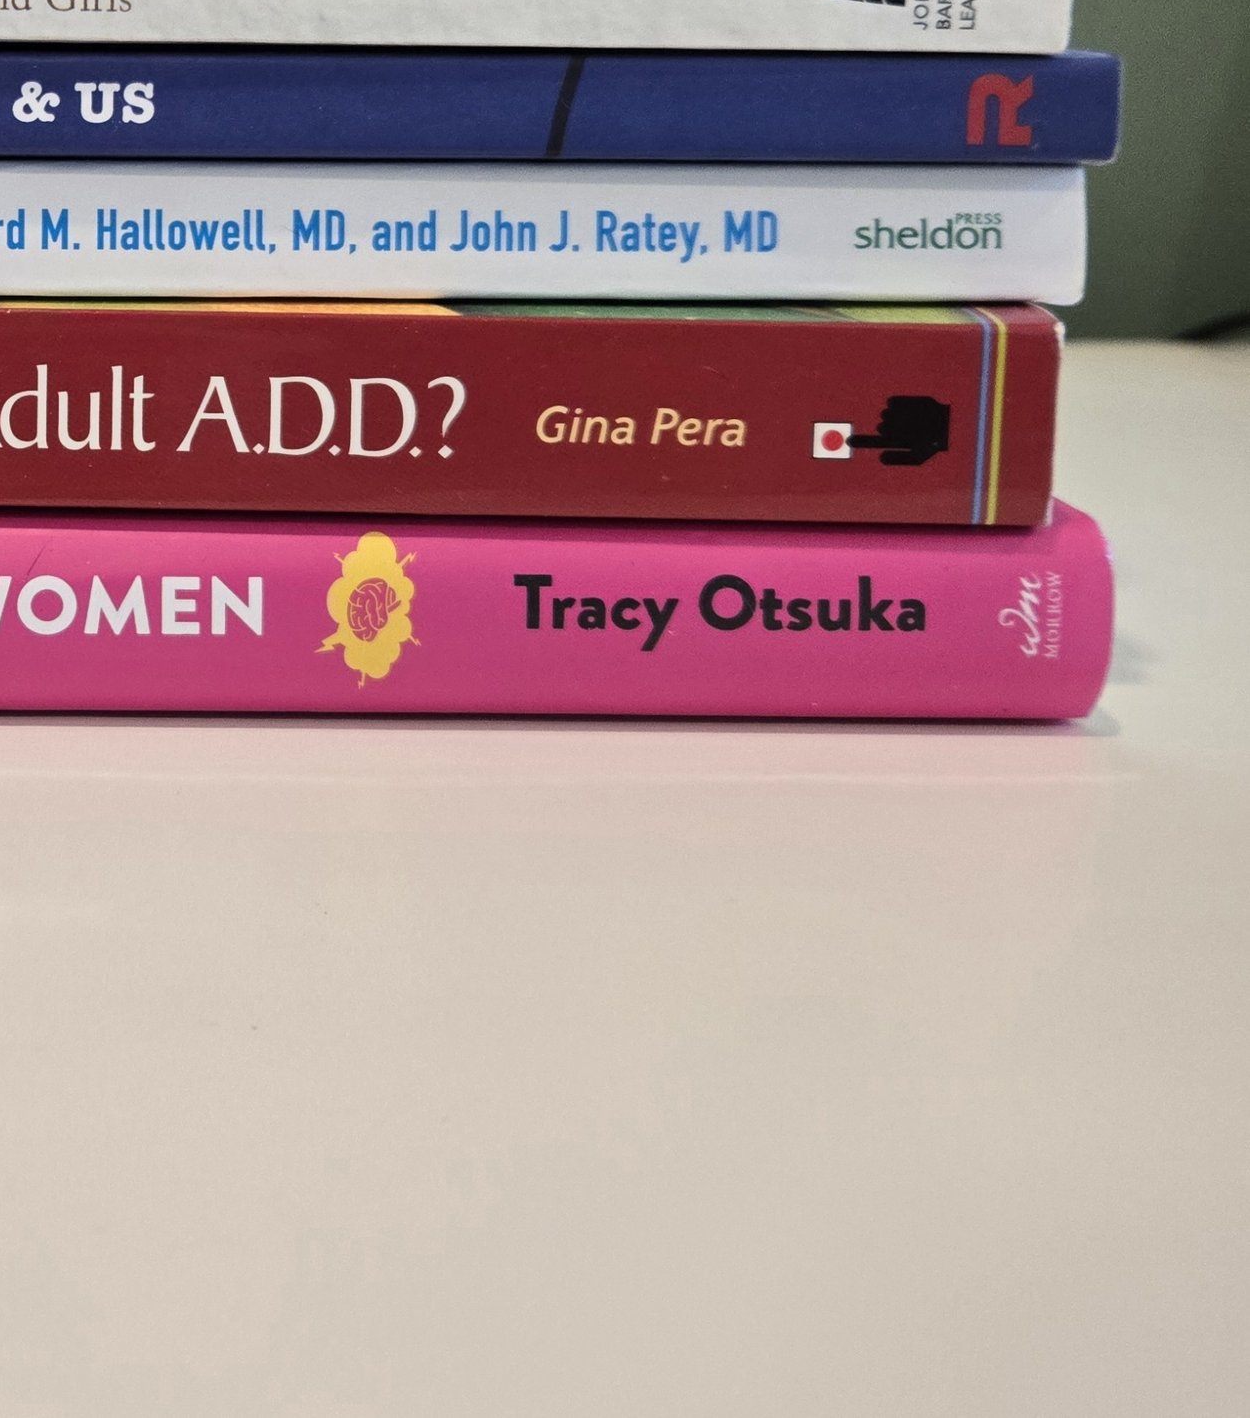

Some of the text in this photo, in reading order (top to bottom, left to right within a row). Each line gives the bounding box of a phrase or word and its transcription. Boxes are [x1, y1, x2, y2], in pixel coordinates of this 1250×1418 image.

[12, 82, 60, 122] &
[75, 82, 154, 124] US
[42, 209, 80, 250] M.
[97, 209, 275, 254] Hallowell,
[293, 210, 356, 254] MD,
[372, 210, 436, 251] and
[450, 210, 536, 251] John
[549, 210, 579, 251] J.
[597, 210, 707, 263] Ratey,
[725, 211, 777, 252] MD
[853, 218, 1003, 249] sheldon
[955, 213, 1002, 224] PRESS
[176, 376, 465, 458] A.D.D.?
[536, 406, 745, 446] Gina Pera
[514, 574, 926, 652] Tracy Otsuka
[1044, 572, 1062, 657] MORROW
